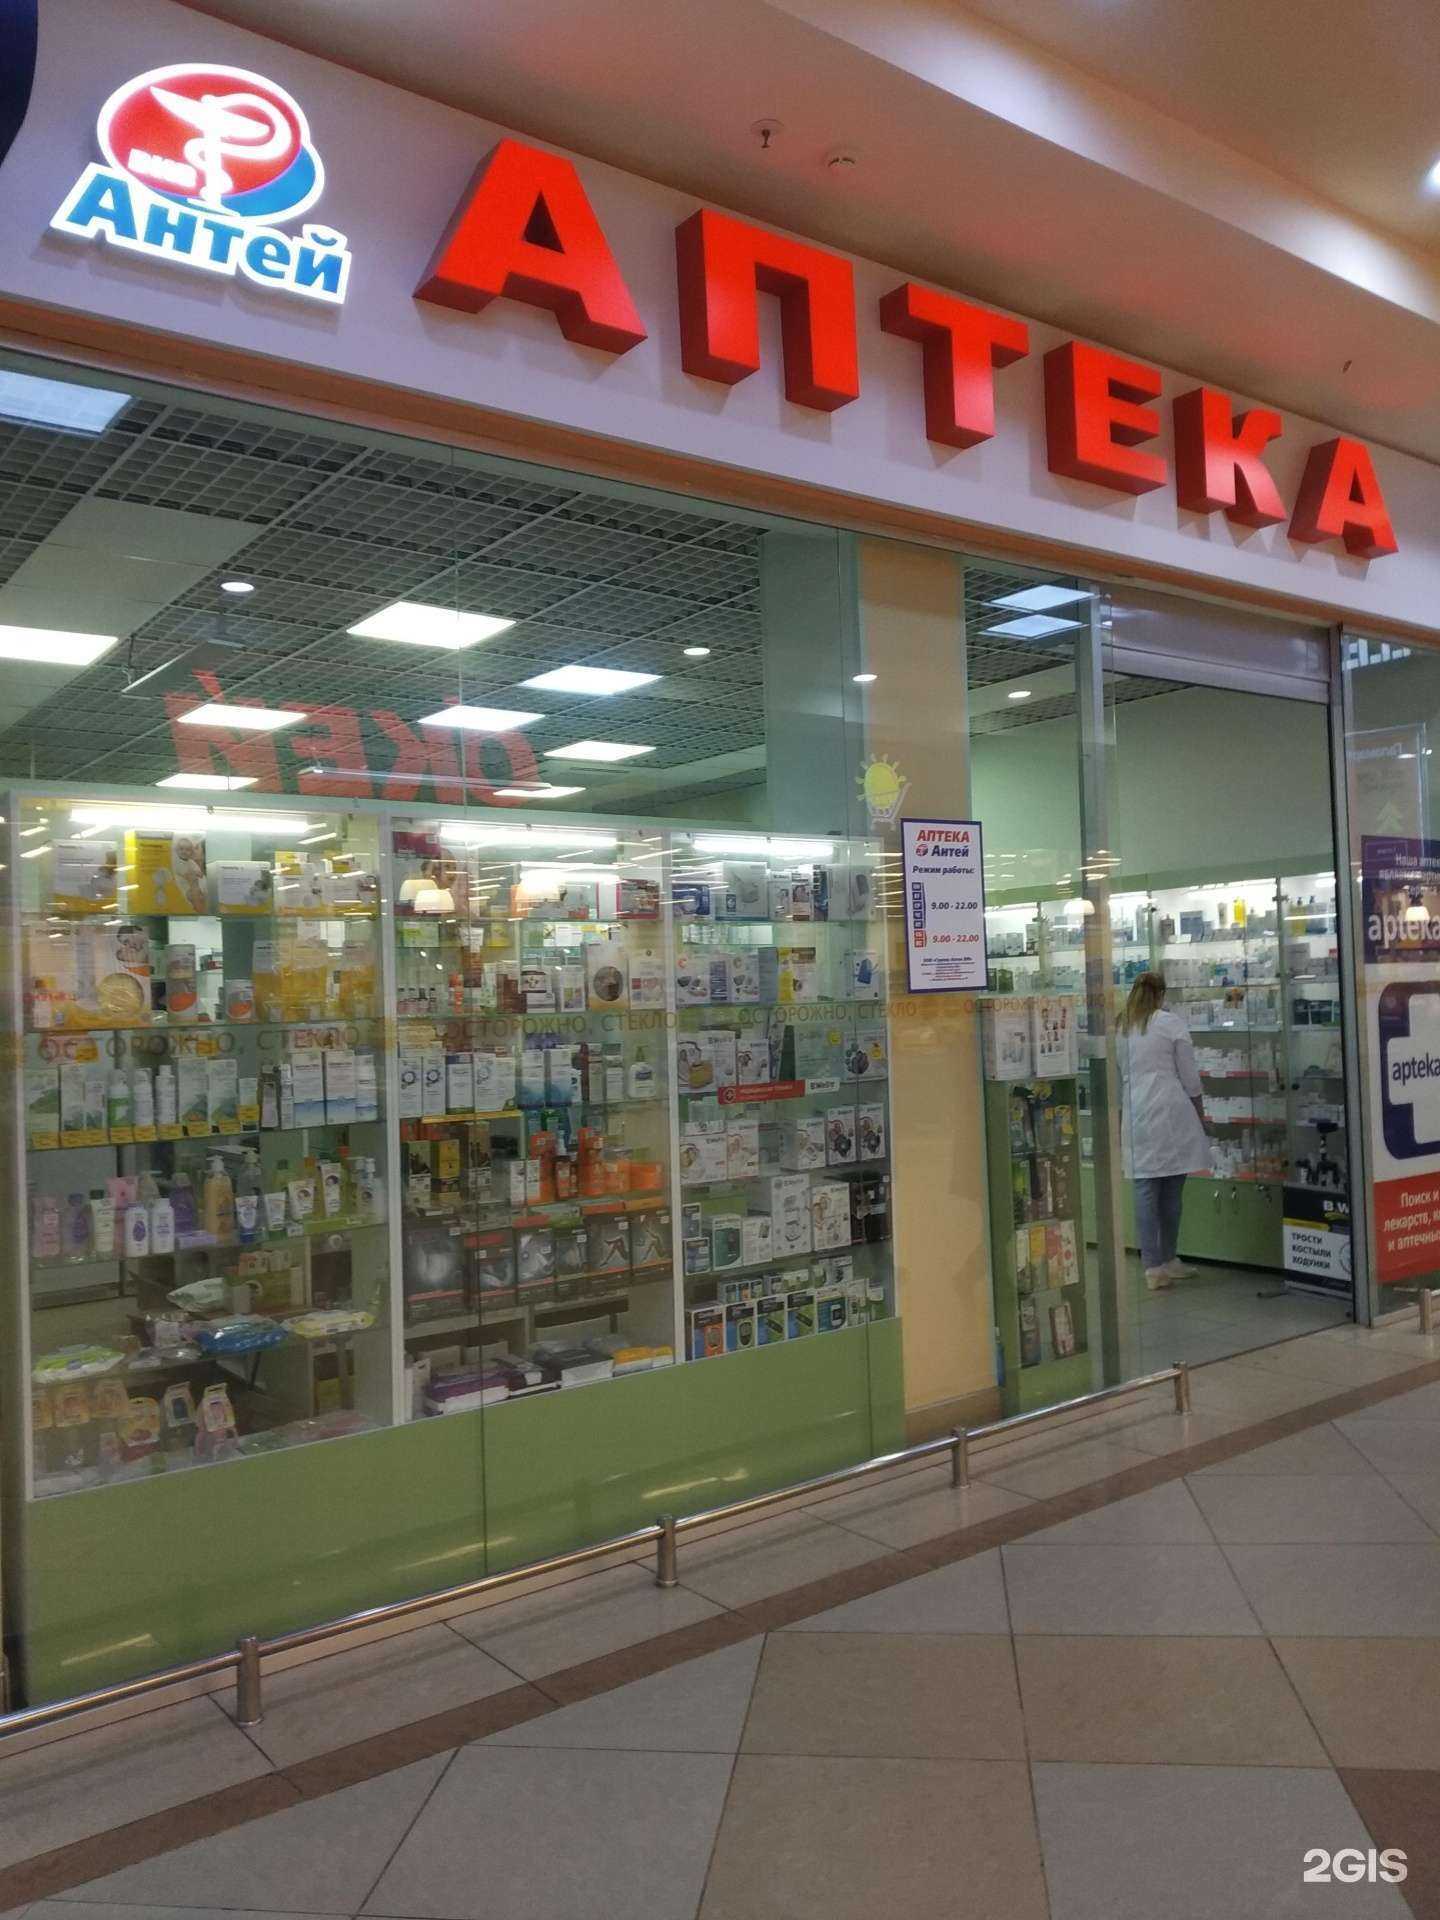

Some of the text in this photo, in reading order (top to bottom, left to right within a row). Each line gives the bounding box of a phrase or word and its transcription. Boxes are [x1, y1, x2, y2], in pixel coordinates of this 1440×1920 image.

[66, 172, 345, 297] Антей
[412, 138, 1398, 562] АПТЕКА
[916, 829, 970, 843] АПТЕКА
[931, 844, 969, 857] Антей
[912, 865, 941, 874] Режим
[931, 902, 950, 910] 9.00
[955, 902, 978, 910] 22.00
[932, 935, 951, 943] 9.00
[956, 934, 979, 942] 22.00
[602, 1011, 678, 1032] СТЕКЛО
[1393, 1052, 1440, 1087] apteka
[1401, 1191, 1431, 1208] Поиск
[1384, 1211, 1431, 1232] лекарств,
[1291, 1232, 1322, 1244] ТРОСТИ
[1292, 1245, 1331, 1258] КОСТЫЛИ
